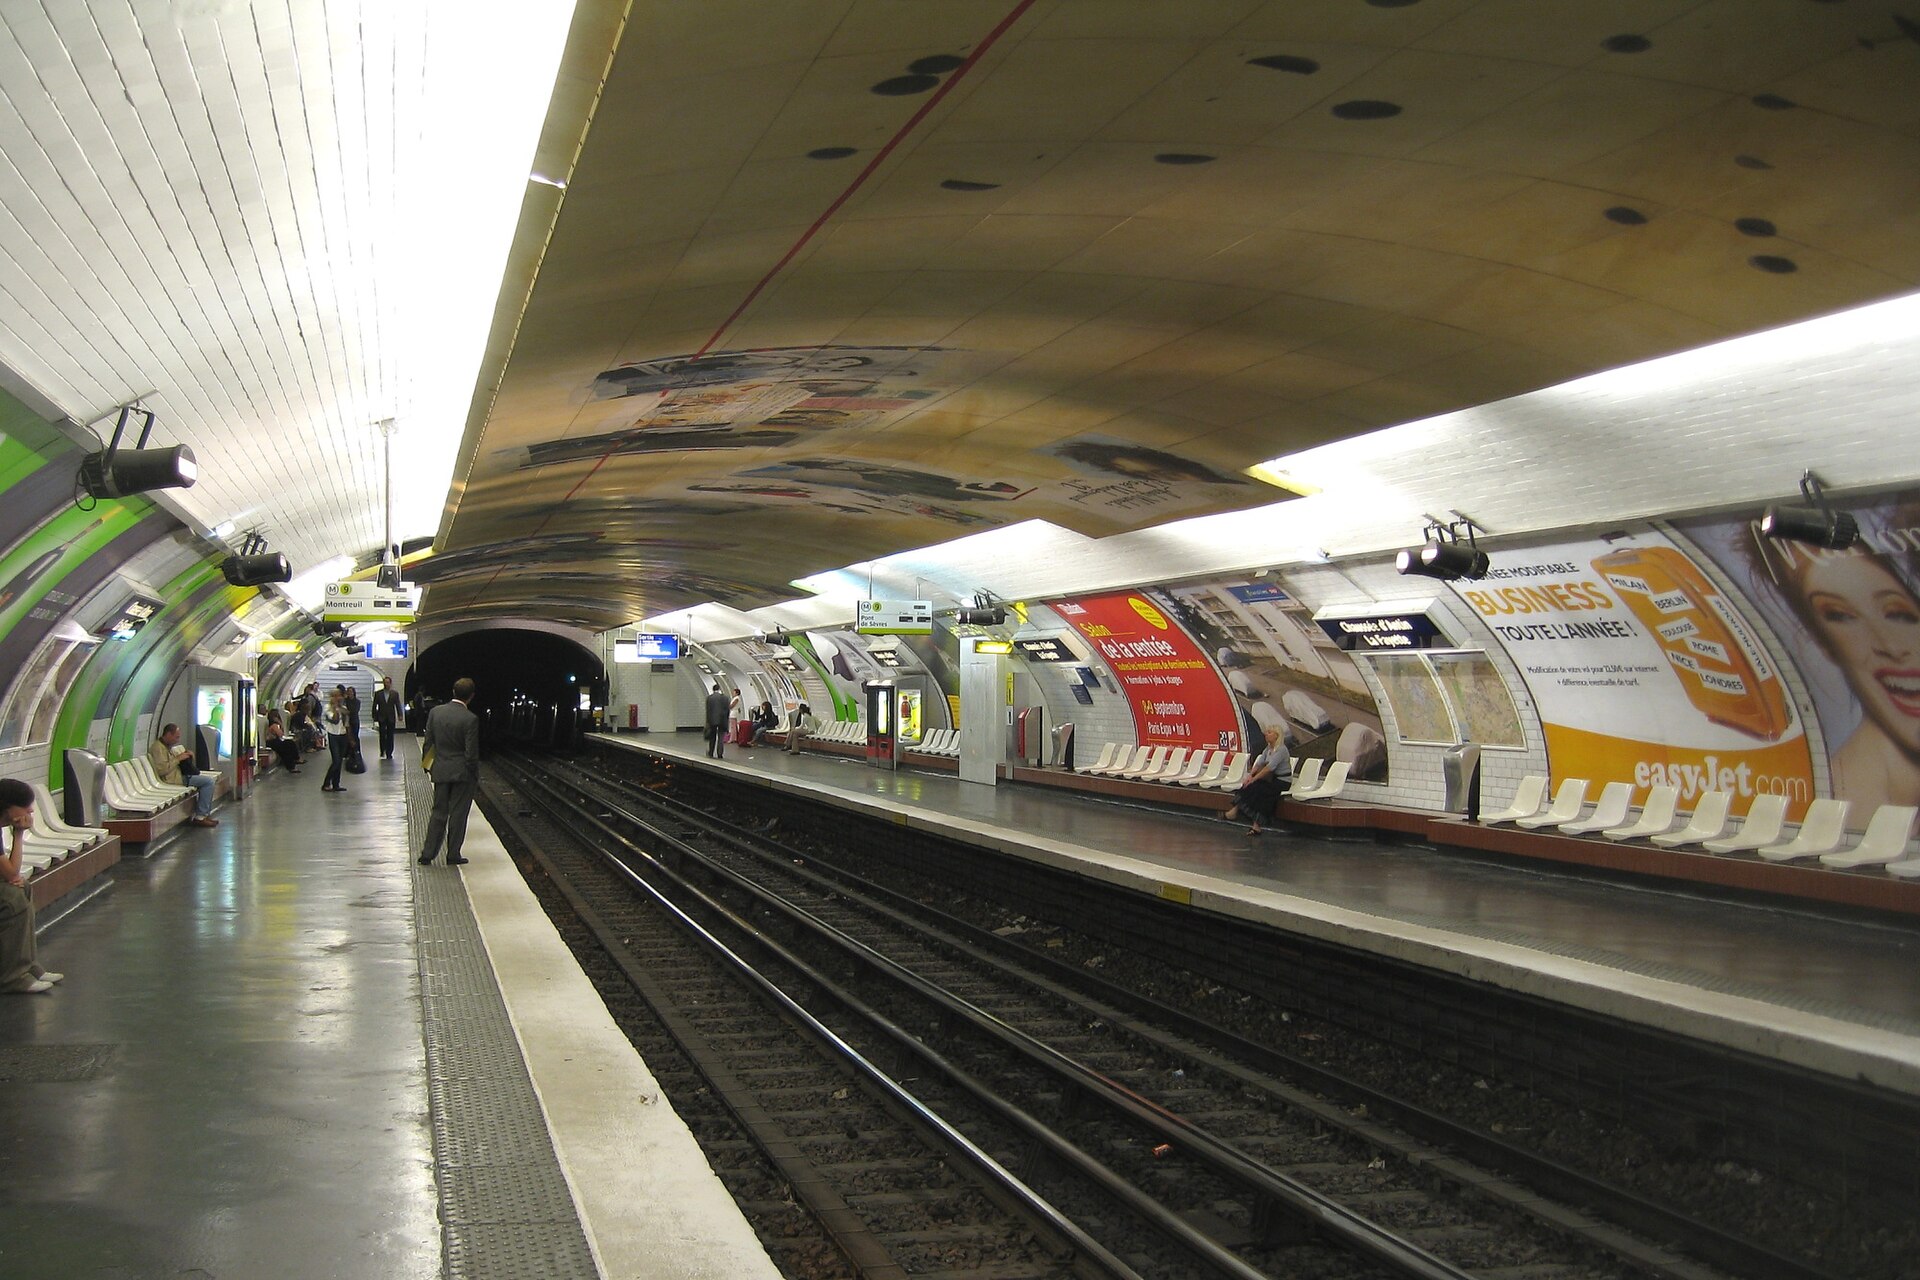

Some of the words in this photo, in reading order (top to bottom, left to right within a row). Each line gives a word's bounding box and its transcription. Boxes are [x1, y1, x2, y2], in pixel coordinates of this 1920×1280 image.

[1507, 562, 1580, 577] MODIFIABLE
[1610, 577, 1649, 592] MILAN
[1464, 581, 1613, 616] BUSINESS
[1655, 596, 1689, 609] BERLIN
[1079, 621, 1113, 638] Salon
[1495, 623, 1556, 641] TOUTE
[1551, 617, 1629, 640] L'ANNÉE
[1625, 621, 1638, 637] !
[1660, 623, 1695, 637] TOULOUSE
[1098, 639, 1121, 659] de
[1110, 638, 1134, 658] la
[1128, 635, 1177, 657] rentrée
[1691, 641, 1720, 656] ROME
[1671, 652, 1696, 670] NICE
[1699, 673, 1744, 690] LONDRES
[1153, 700, 1186, 718] septembre
[1147, 721, 1161, 735] Paris
[1160, 722, 1173, 738] Expo
[1634, 755, 1808, 803] easyJet.com
